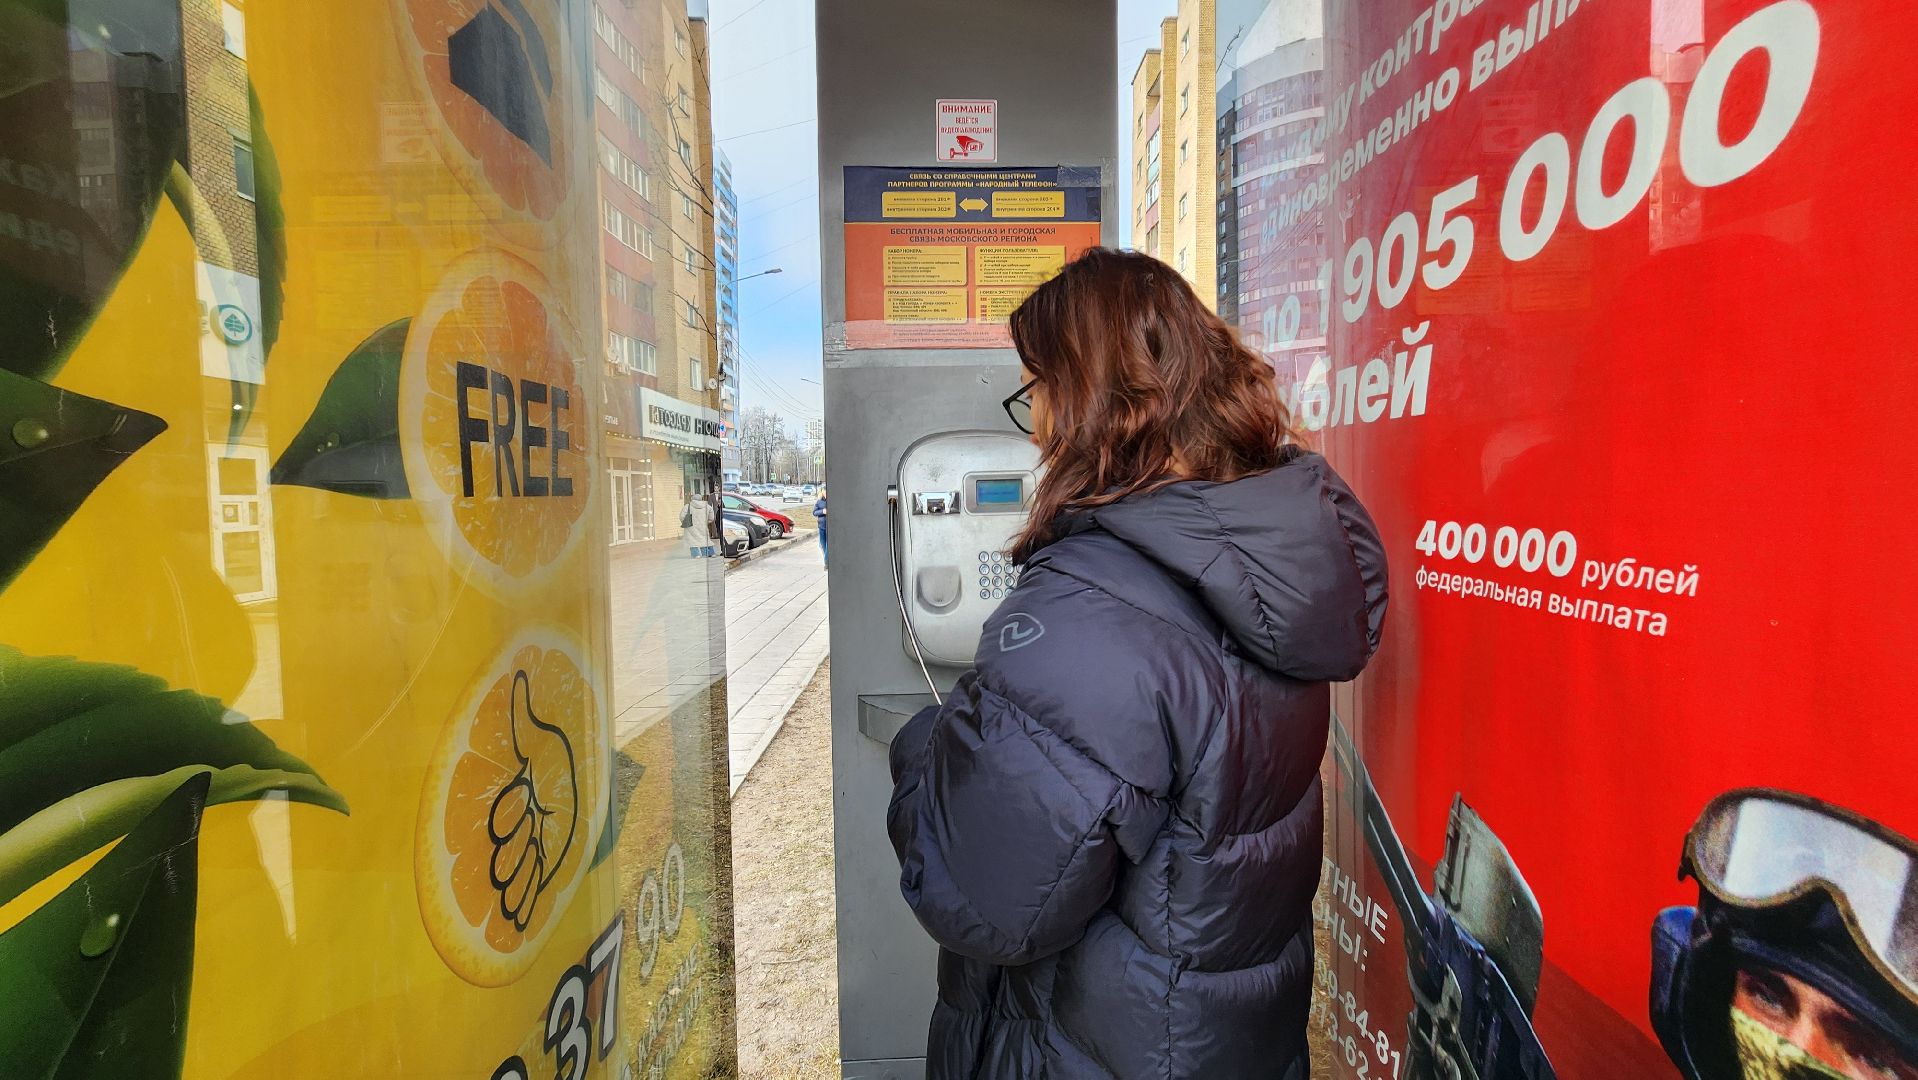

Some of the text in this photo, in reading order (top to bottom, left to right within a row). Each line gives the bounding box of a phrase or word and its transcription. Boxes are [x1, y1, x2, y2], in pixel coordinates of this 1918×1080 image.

[942, 105, 992, 114] ВНИМАНИЕ
[976, 180, 1020, 188] «НАРОДНЫЙ
[999, 173, 1037, 181] ЦЕНТРАМИ
[1260, 67, 1460, 248] единовременно
[456, 361, 574, 498] FREE
[1416, 520, 1700, 597] 400 000 рублей
[1415, 565, 1669, 637] федеральная выплата
